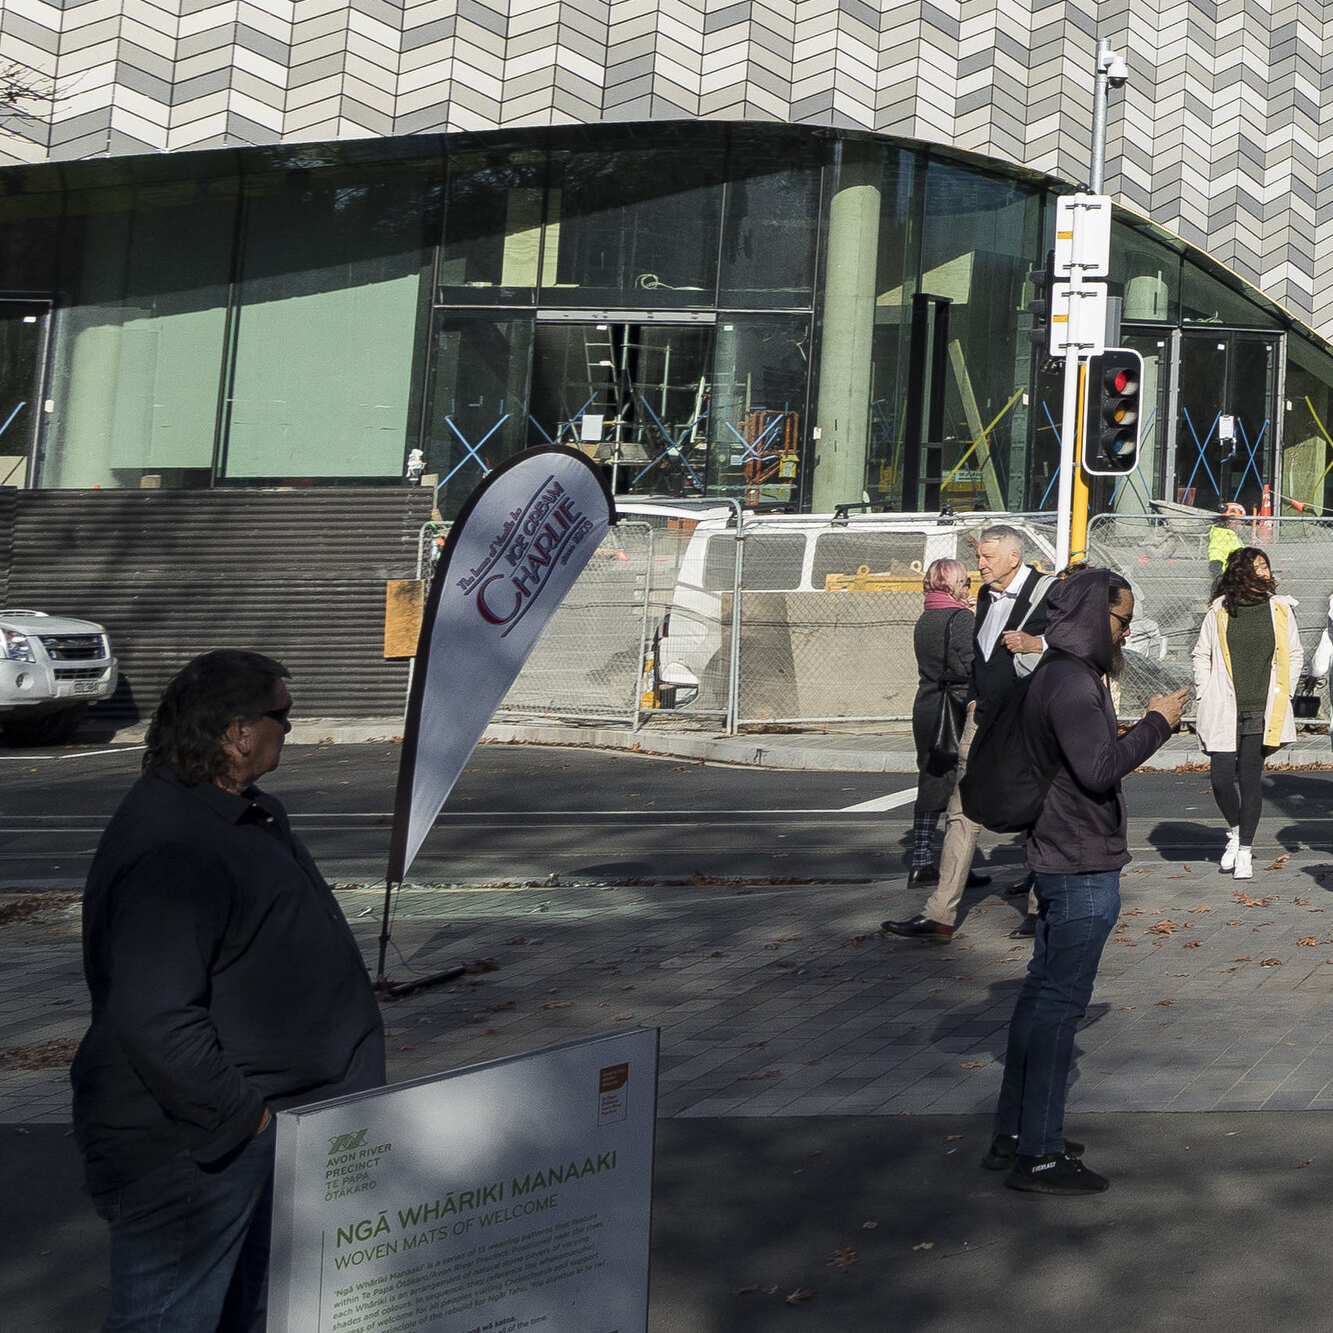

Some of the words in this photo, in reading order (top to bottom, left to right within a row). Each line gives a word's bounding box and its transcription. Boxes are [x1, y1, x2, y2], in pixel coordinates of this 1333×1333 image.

[504, 534, 529, 566] ICE
[523, 481, 565, 536] CREAM
[456, 575, 475, 590] The
[470, 557, 492, 578] home
[489, 543, 499, 558] of
[476, 496, 583, 625] CHARLIE
[325, 1157, 381, 1180] PRECINCT
[326, 1153, 356, 1168] AVON
[359, 1143, 392, 1159] RIVER
[326, 1180, 338, 1190] TE
[342, 1172, 369, 1187] PAPA
[336, 1210, 391, 1249] NGĀ
[397, 1182, 505, 1229] WHĀRIKI
[512, 1150, 618, 1198] MANAAKI
[335, 1240, 397, 1271] WOVEN
[403, 1225, 449, 1251] MATS
[452, 1217, 475, 1237] OF
[478, 1193, 559, 1228] WELCOME
[333, 1307, 352, 1320] each
